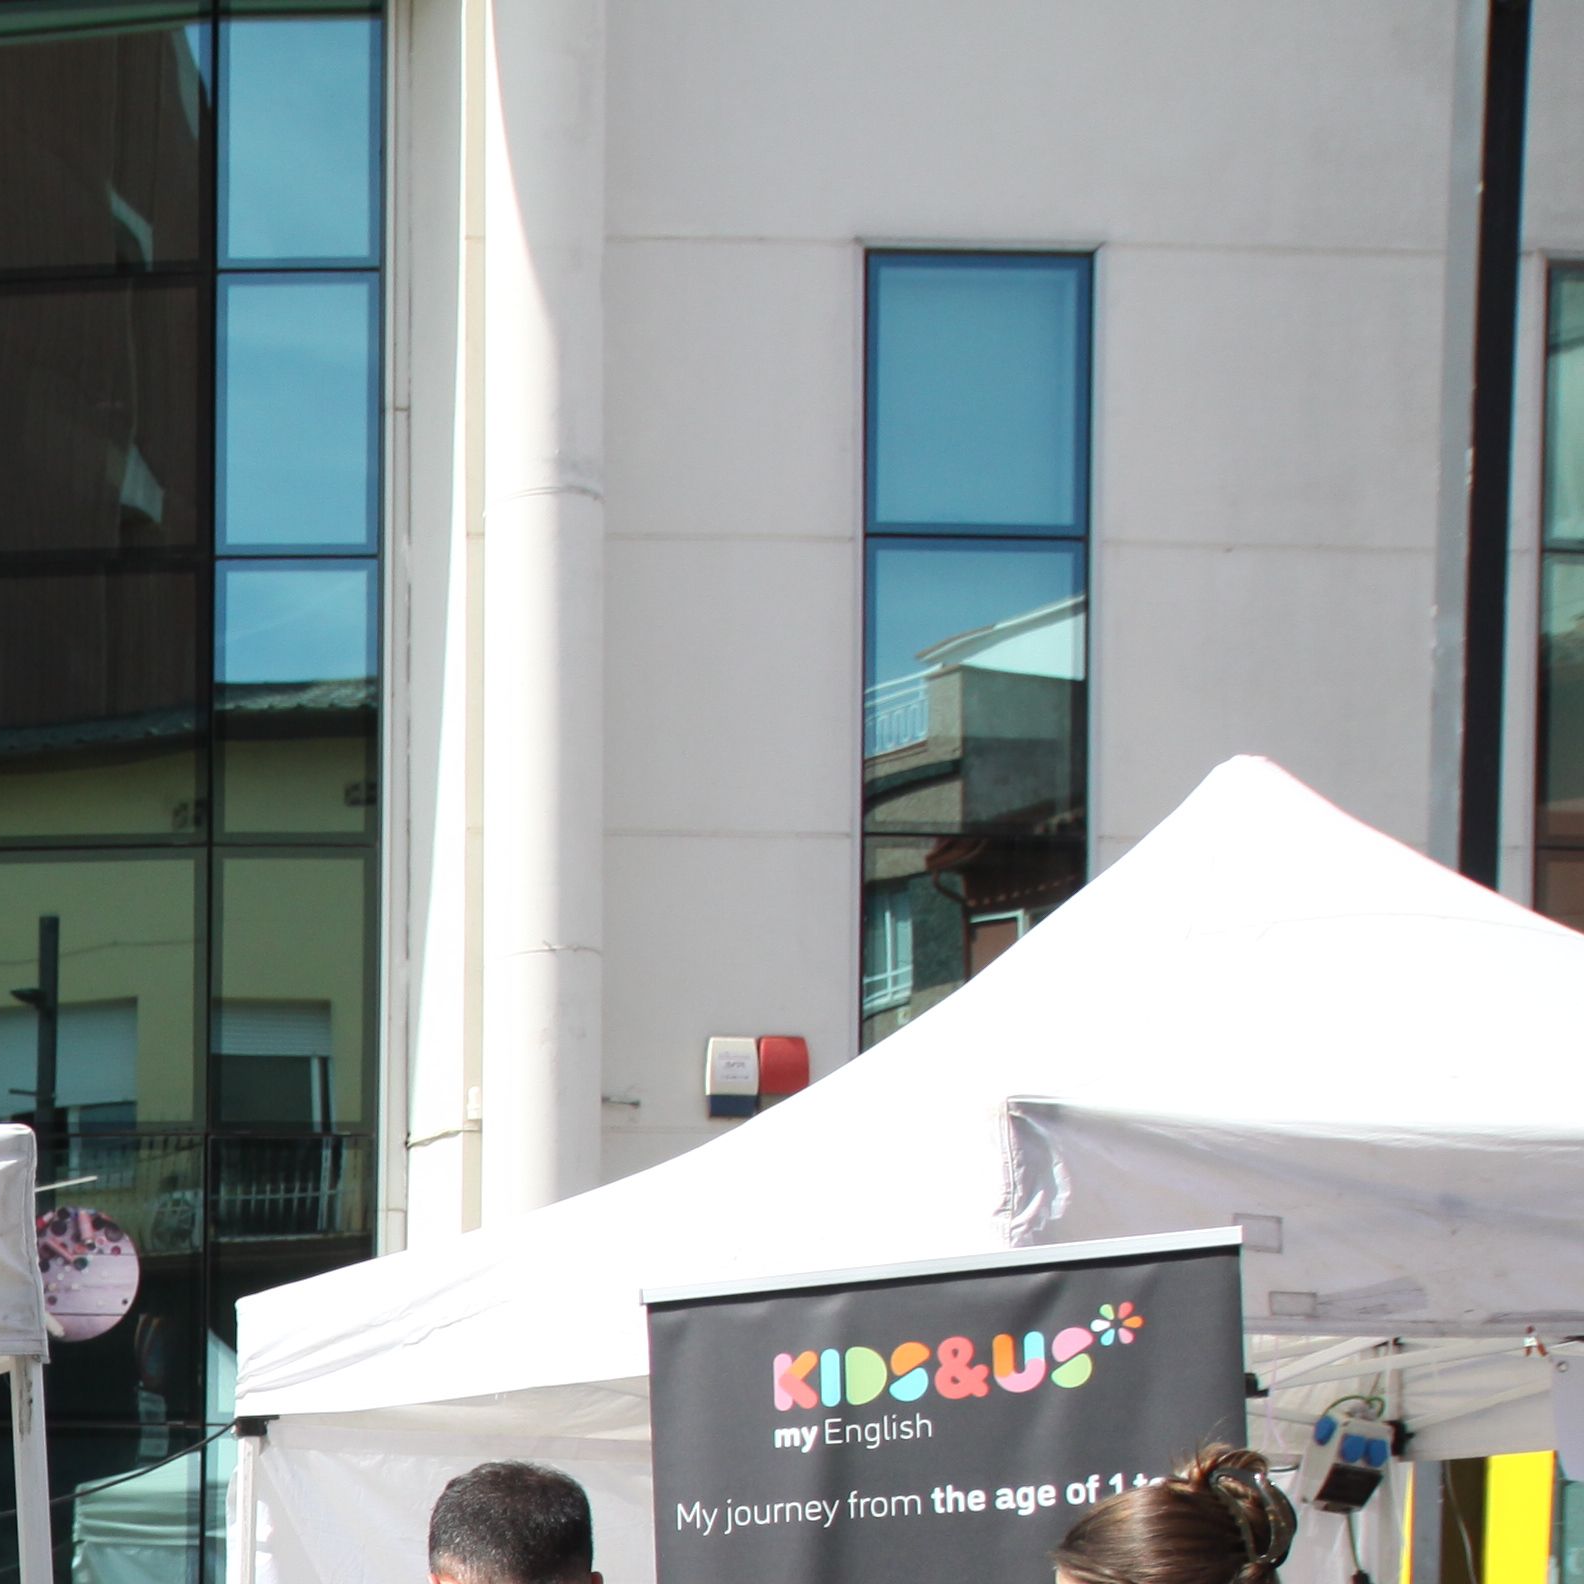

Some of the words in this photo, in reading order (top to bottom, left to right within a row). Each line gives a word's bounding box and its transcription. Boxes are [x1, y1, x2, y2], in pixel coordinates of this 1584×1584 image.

[772, 1326, 1094, 1412] KIDS&US
[772, 1423, 819, 1454] my
[824, 1412, 933, 1449] English
[675, 1500, 719, 1537] My
[724, 1496, 840, 1535] journey
[847, 1489, 922, 1521] from
[930, 1482, 991, 1516] the
[995, 1482, 1058, 1518] age
[1065, 1474, 1100, 1507] of
